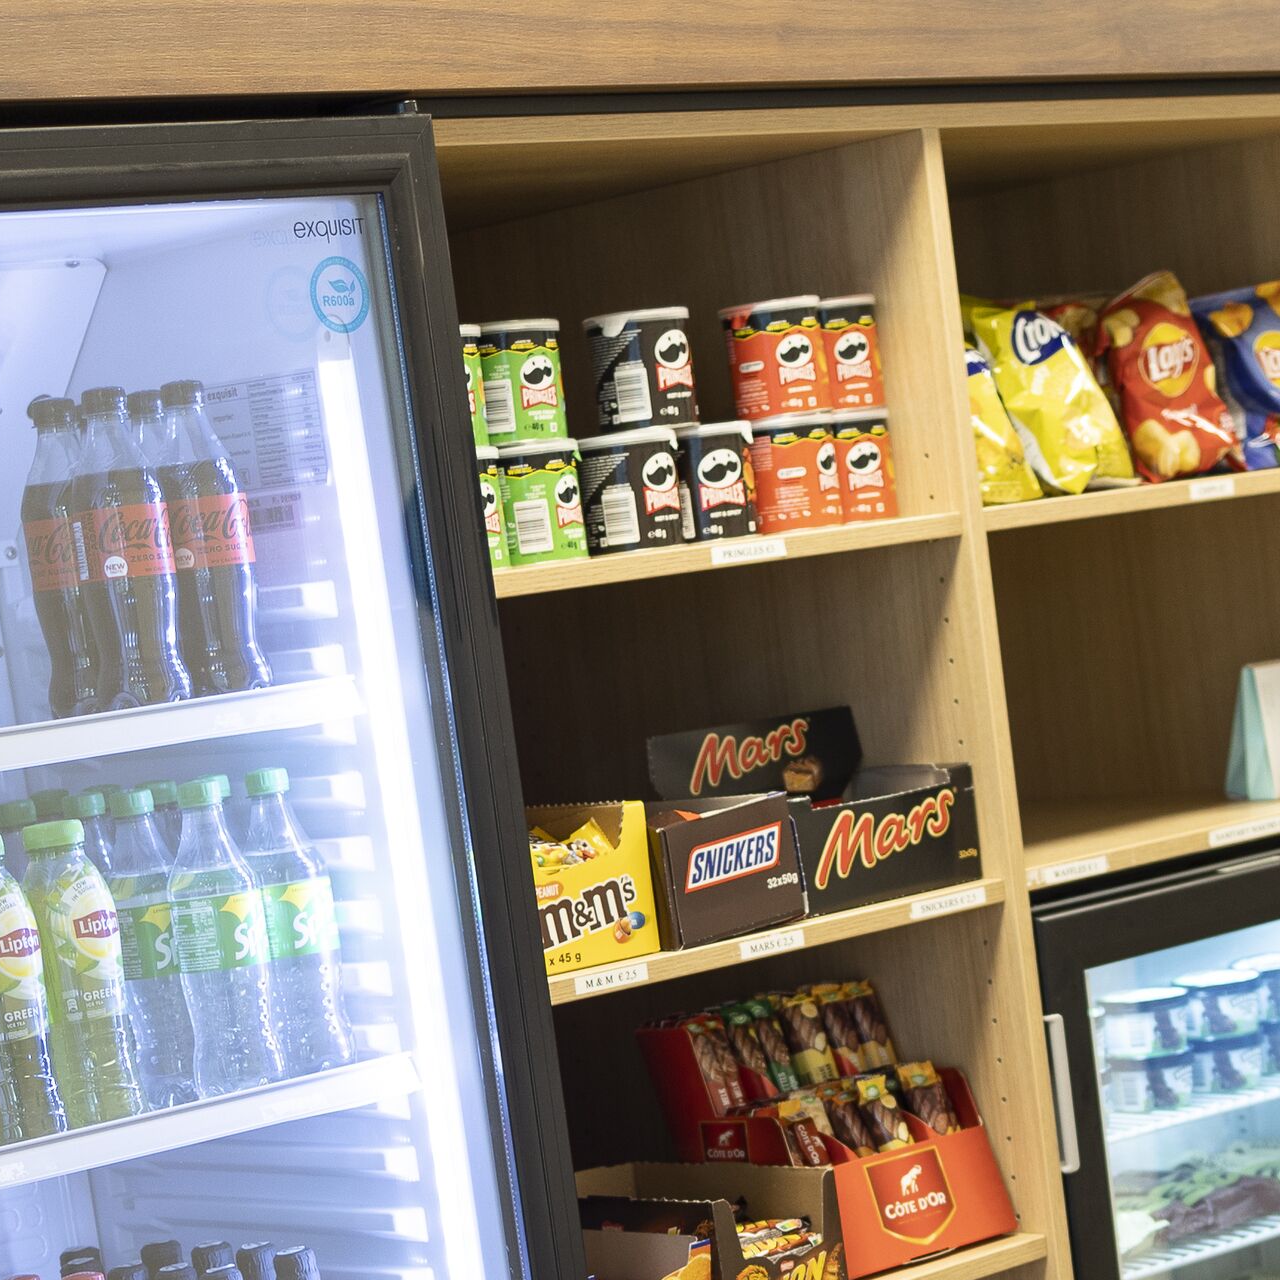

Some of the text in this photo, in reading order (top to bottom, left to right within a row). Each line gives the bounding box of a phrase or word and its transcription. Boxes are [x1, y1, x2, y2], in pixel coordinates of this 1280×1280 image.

[322, 295, 355, 307] R600a
[106, 562, 125, 572] NEW
[690, 718, 808, 795] Mars
[815, 789, 955, 890] Mars
[691, 830, 775, 885] SNICKERS
[72, 880, 87, 892] LOW
[767, 872, 799, 890] 32x50g
[79, 911, 120, 935] Lipton
[0, 931, 40, 954] Lipton
[750, 938, 775, 954] MARS
[558, 952, 572, 964] 45
[575, 952, 582, 963] g
[585, 978, 594, 989] M
[596, 977, 603, 987] &
[605, 975, 614, 984] M
[4, 1006, 40, 1023] GREEN
[884, 1191, 947, 1219] CÔTE D'OR
